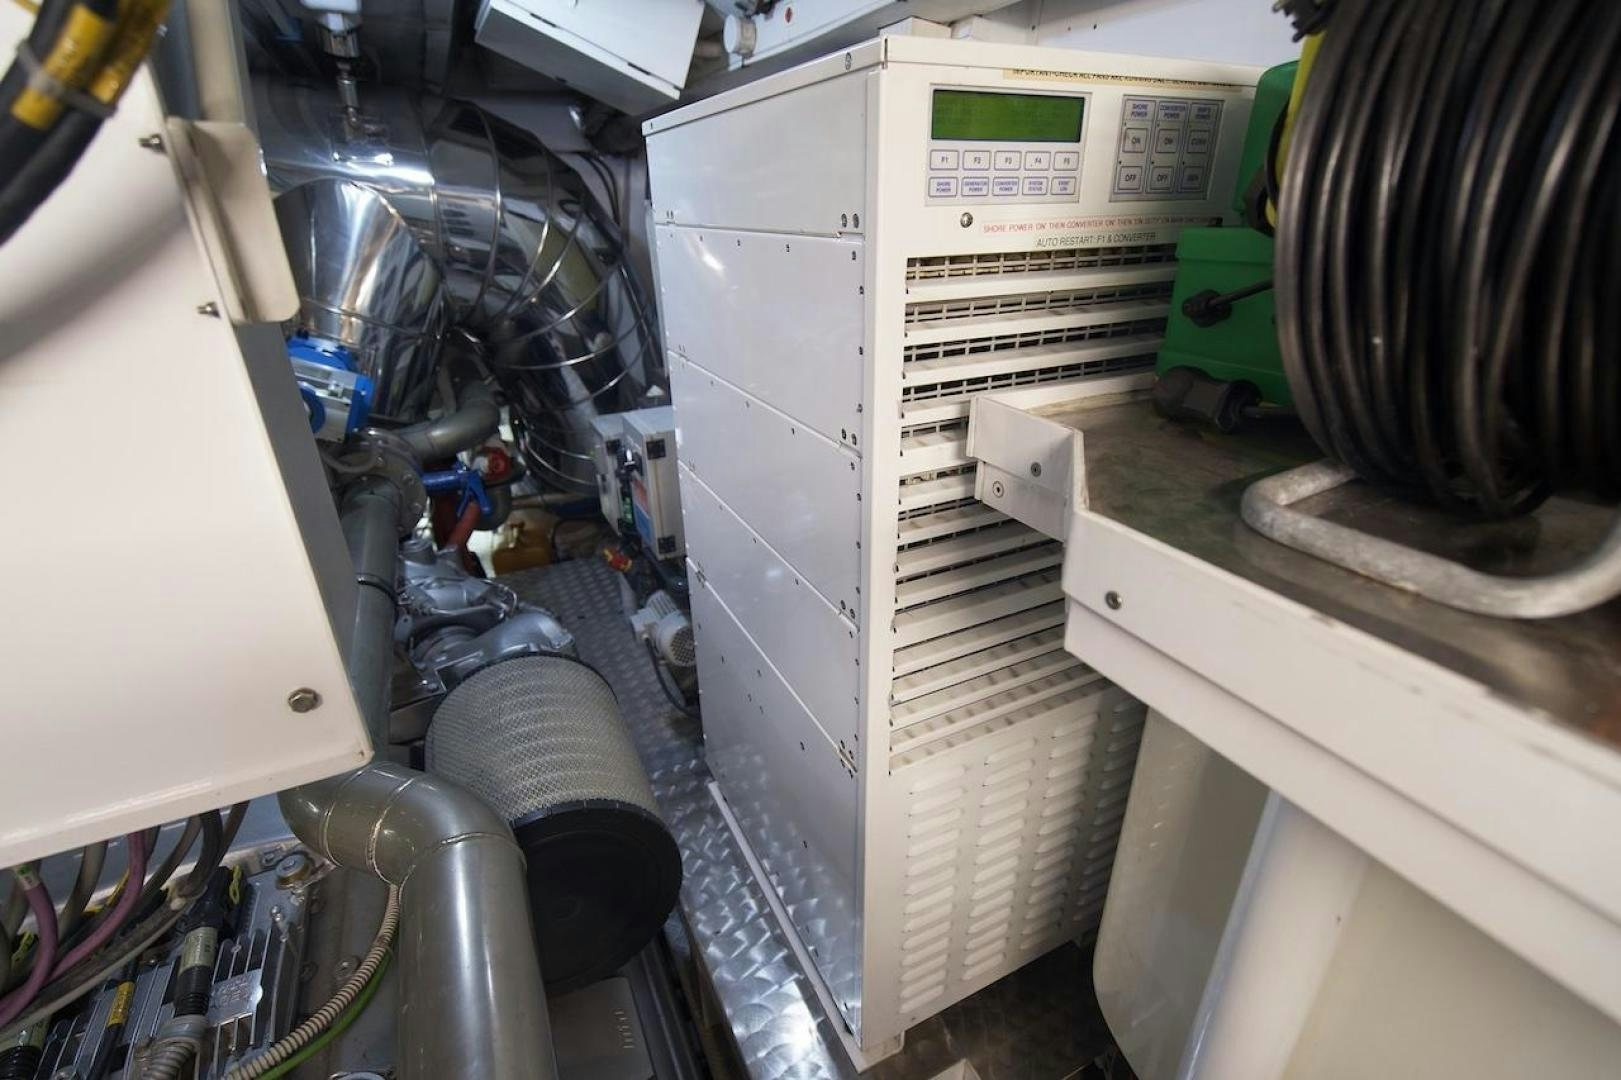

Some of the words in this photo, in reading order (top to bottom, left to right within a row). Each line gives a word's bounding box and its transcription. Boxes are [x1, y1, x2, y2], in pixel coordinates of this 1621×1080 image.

[1131, 136, 1141, 144] ON
[1164, 137, 1174, 145] ON
[940, 156, 949, 164] F1
[973, 156, 982, 165] F2
[1004, 157, 1013, 165] F3
[1034, 157, 1043, 165] F4
[1125, 174, 1137, 182] OFF
[1157, 174, 1168, 182] OFF
[983, 224, 1006, 233] SHORE
[1008, 223, 1034, 232] POWER
[1049, 221, 1066, 230] THEN
[1066, 219, 1104, 229] CONVERTER
[1036, 237, 1058, 248] AUTO
[1097, 235, 1105, 243] F1
[1107, 234, 1113, 242] &
[1113, 232, 1157, 243] CONVERTER
